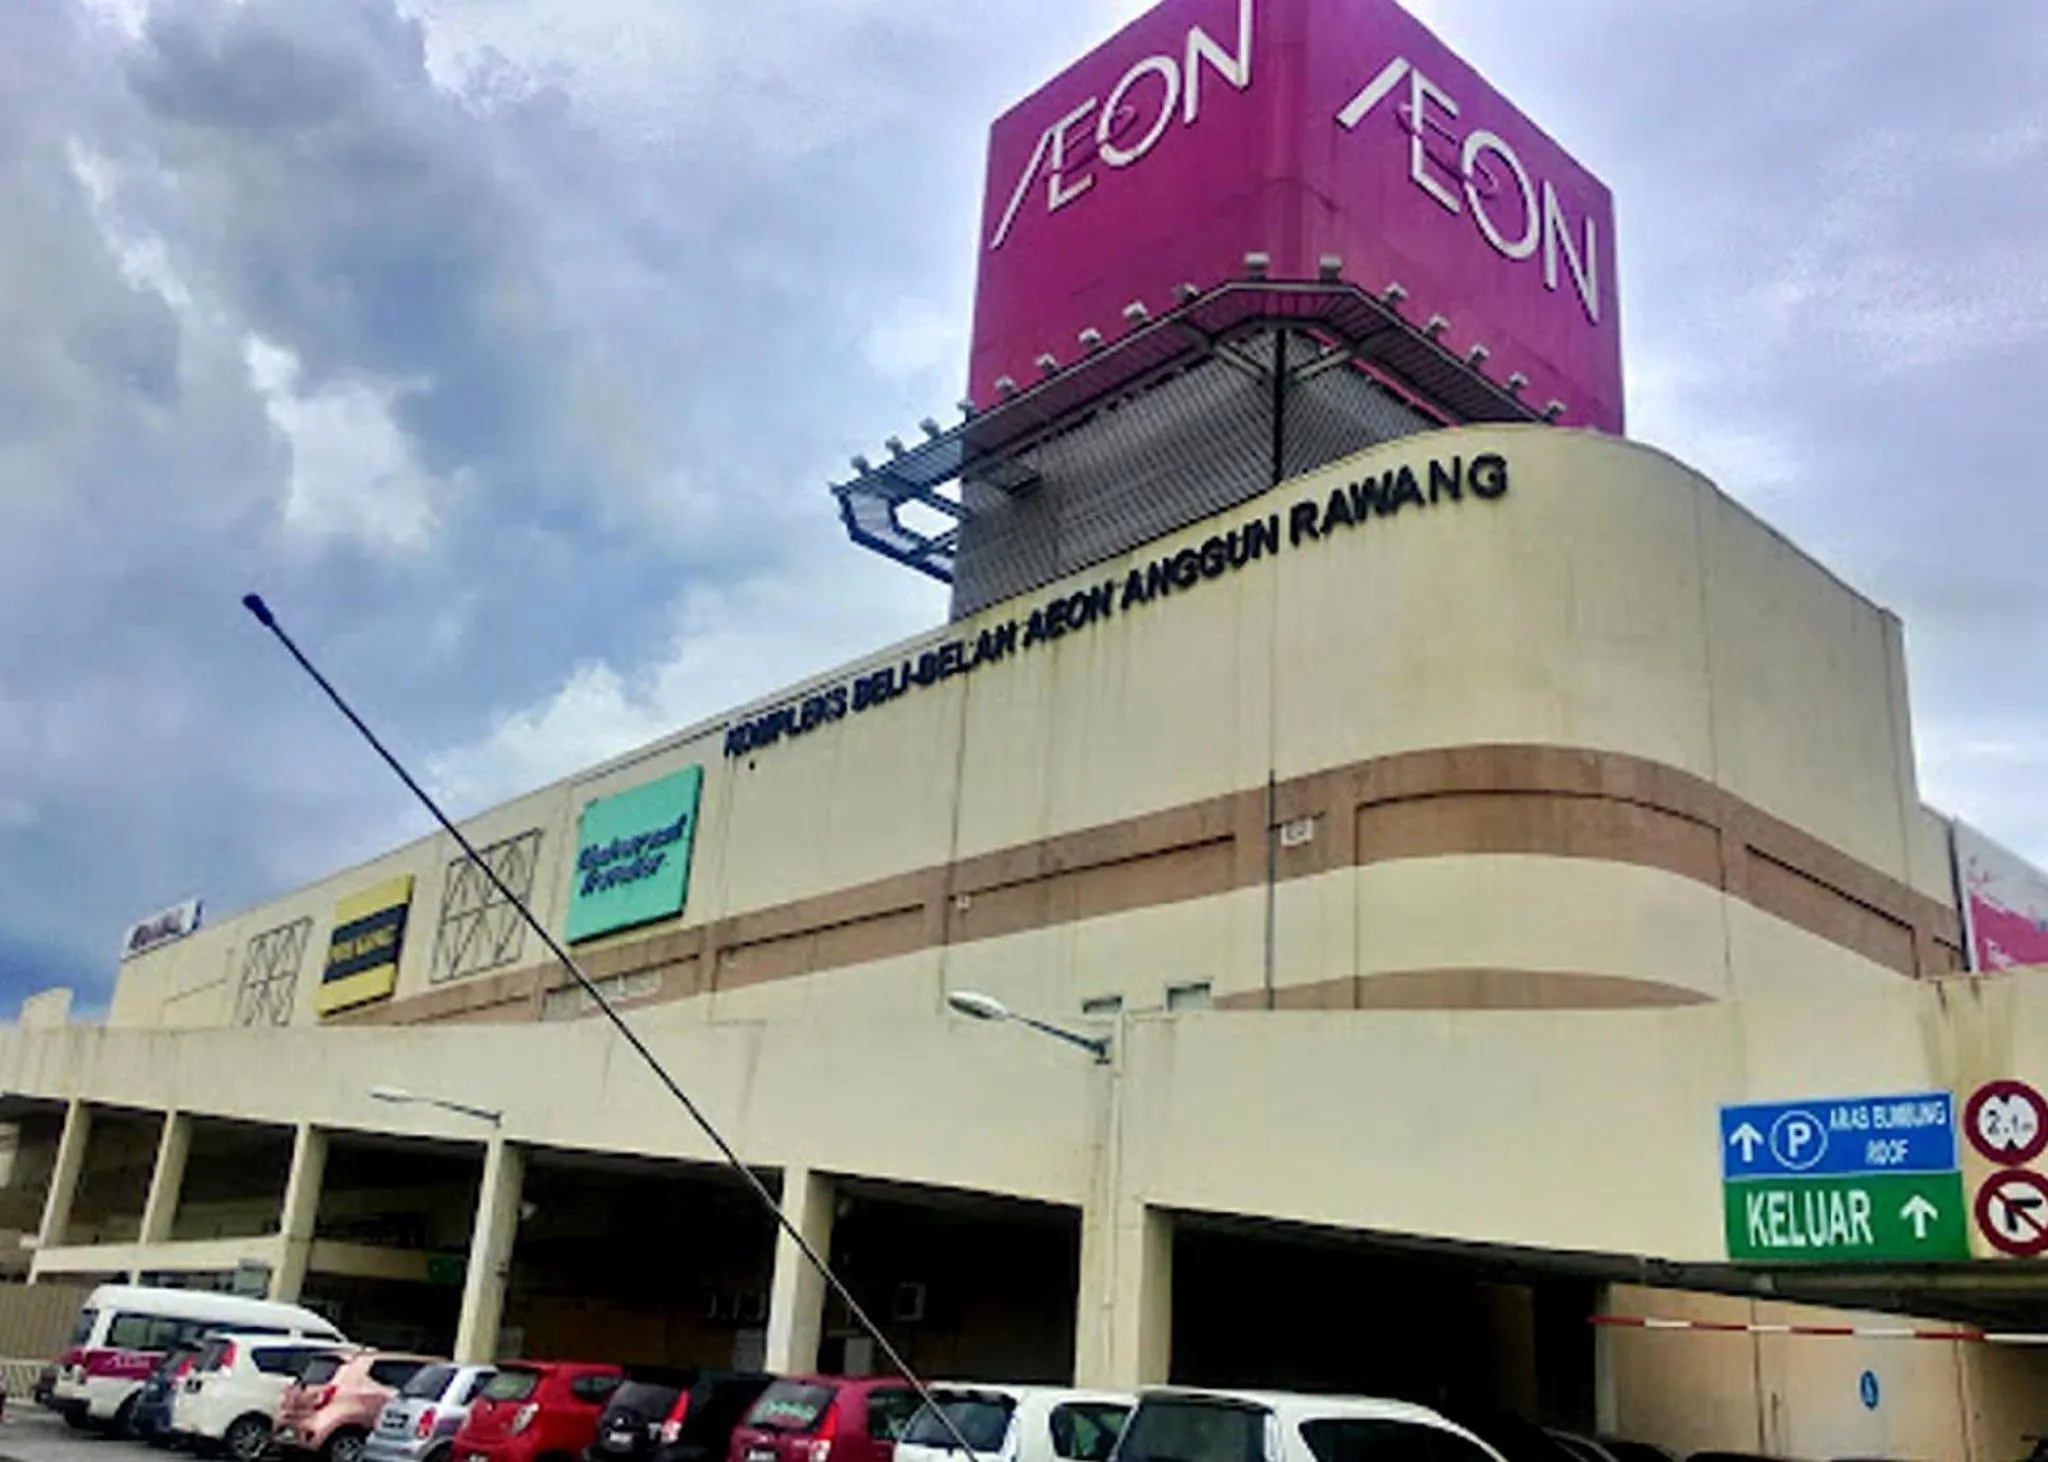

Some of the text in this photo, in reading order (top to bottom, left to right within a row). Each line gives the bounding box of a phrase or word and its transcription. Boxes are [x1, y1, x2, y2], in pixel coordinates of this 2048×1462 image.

[990, 0, 1252, 250] AEON
[1336, 56, 1598, 323] AEON
[1023, 579, 1114, 650] AEON
[1121, 514, 1280, 611] ANGGUN
[1290, 453, 1509, 547] RAWANG
[1746, 1189, 1875, 1248] KELUAR
